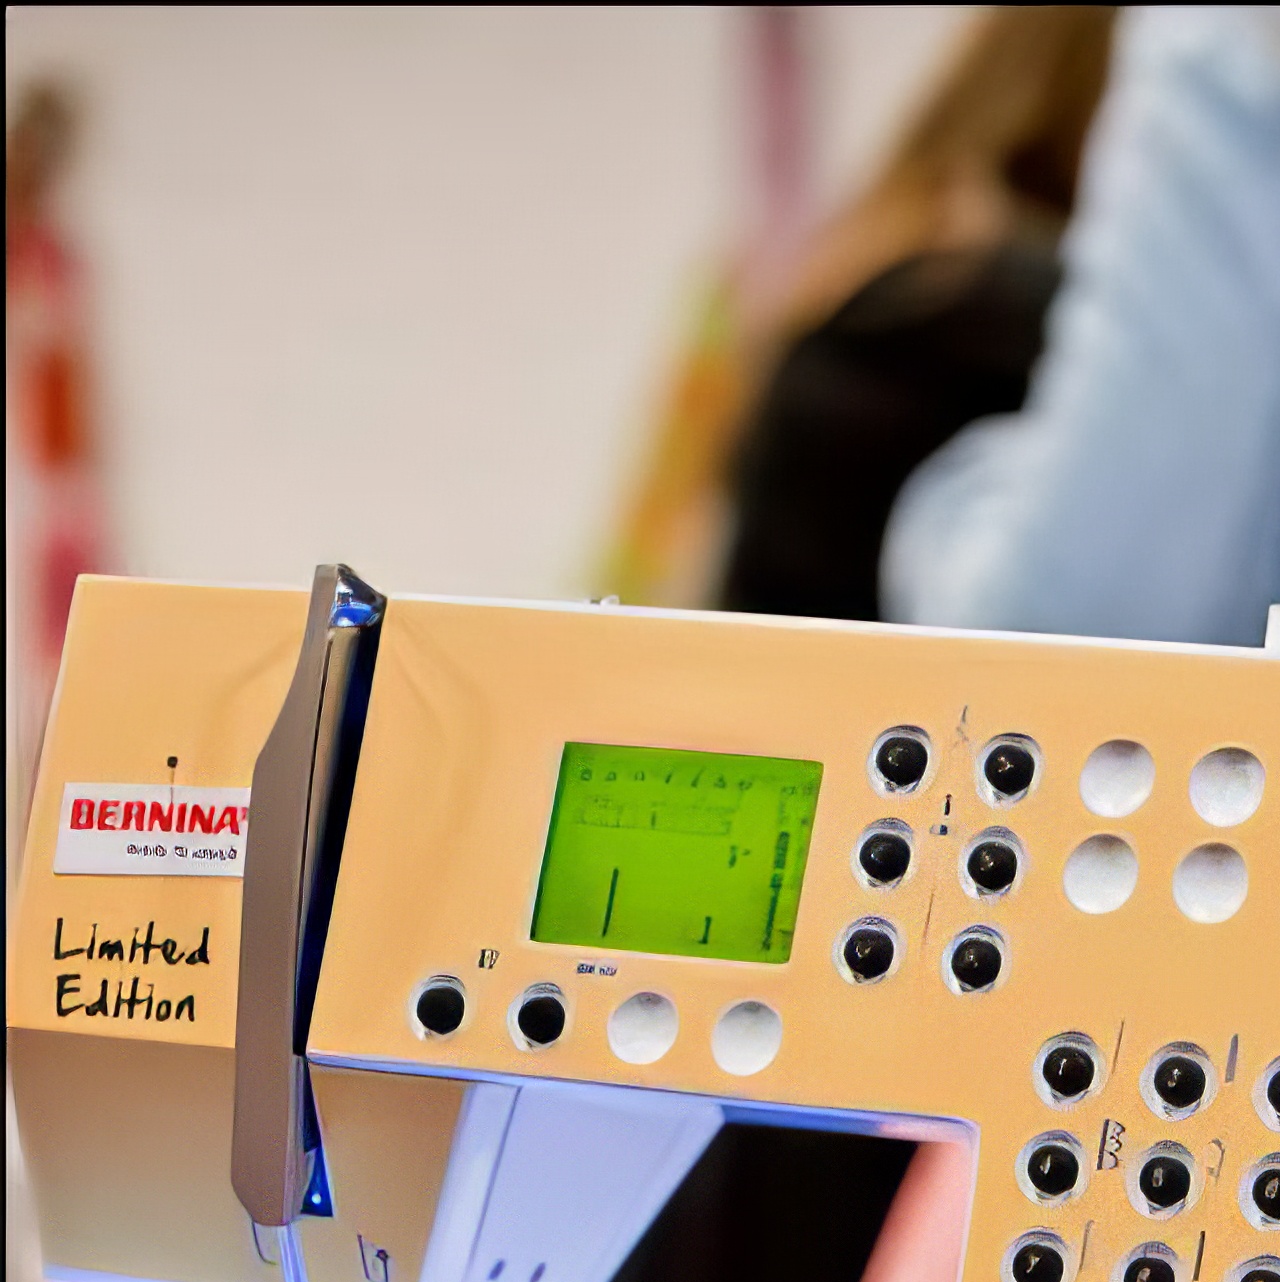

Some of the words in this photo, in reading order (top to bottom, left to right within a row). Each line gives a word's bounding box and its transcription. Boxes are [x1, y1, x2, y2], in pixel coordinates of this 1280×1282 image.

[70, 798, 241, 836] BERNINA
[53, 916, 211, 966] Limited
[55, 973, 196, 1022] Edition
